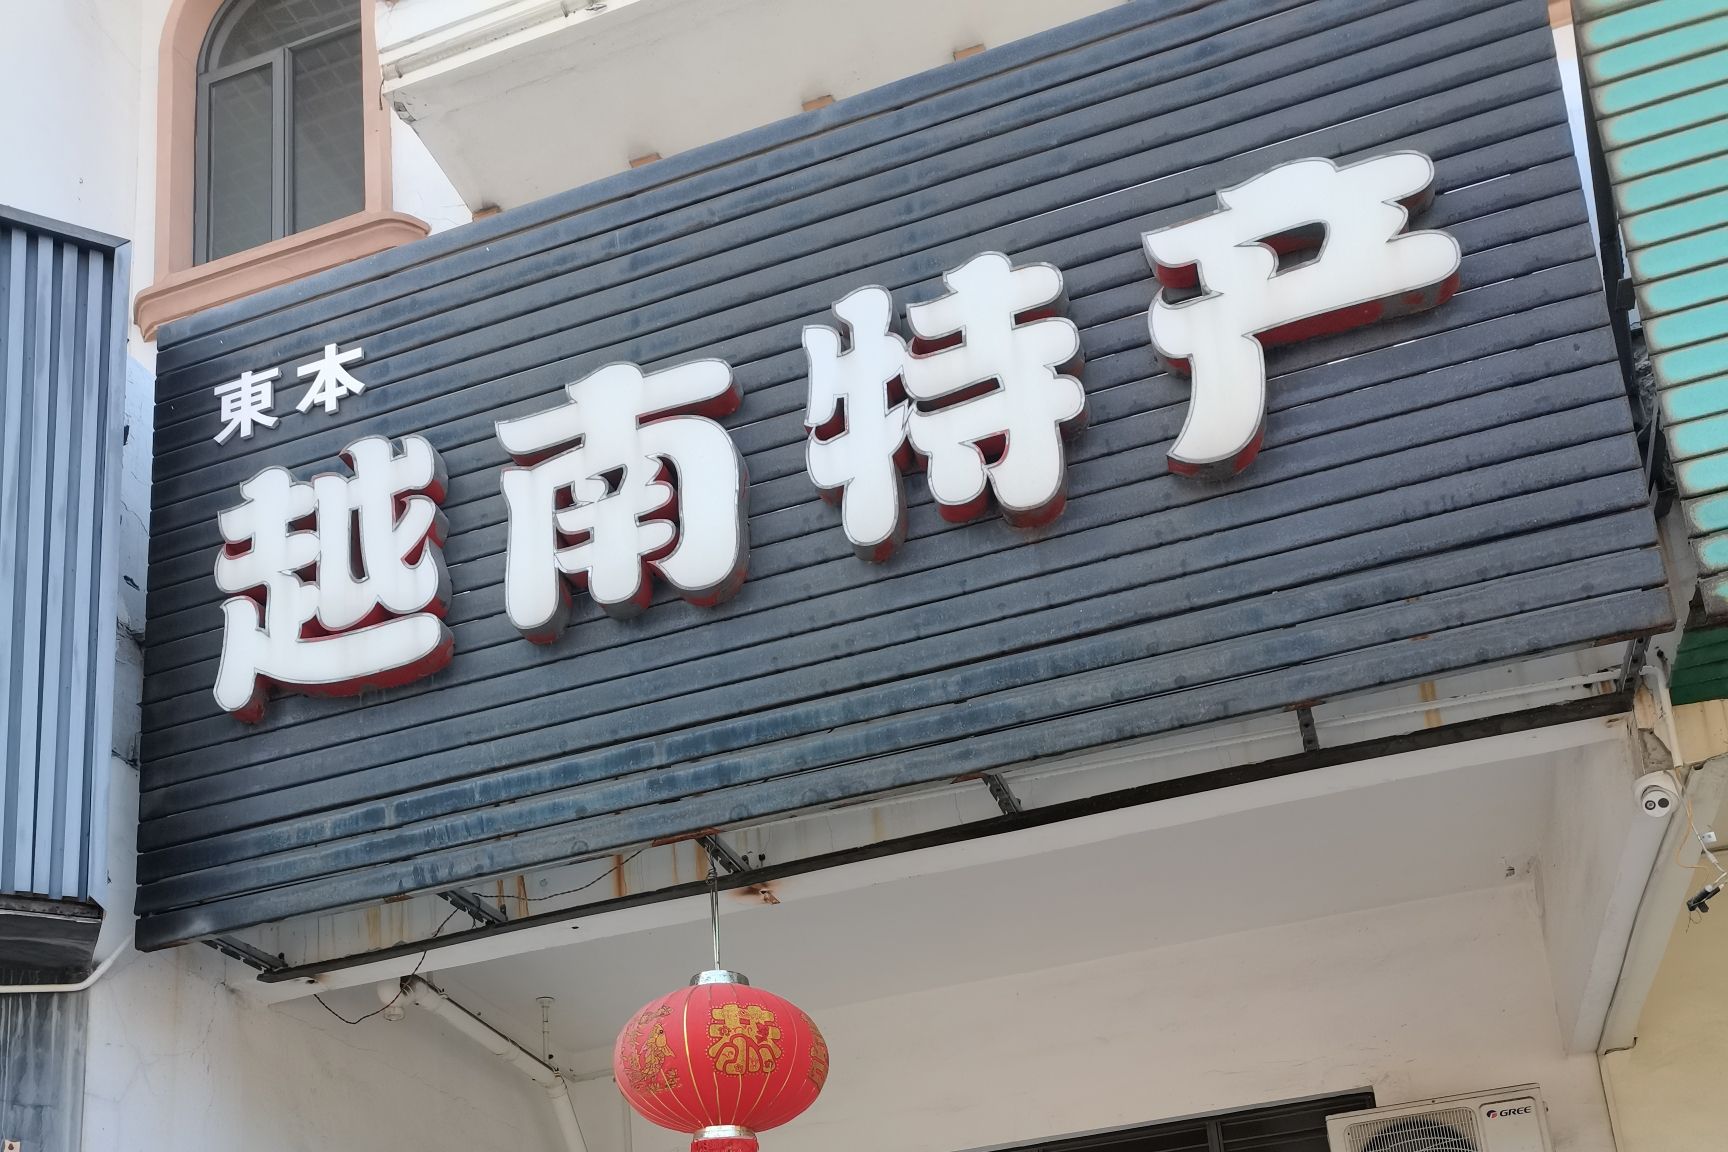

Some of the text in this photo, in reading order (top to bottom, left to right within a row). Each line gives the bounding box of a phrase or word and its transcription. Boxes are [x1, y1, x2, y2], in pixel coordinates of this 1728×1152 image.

[212, 343, 366, 445] 東本
[212, 150, 1462, 714] 越南特产
[1499, 1105, 1532, 1117] GREE
